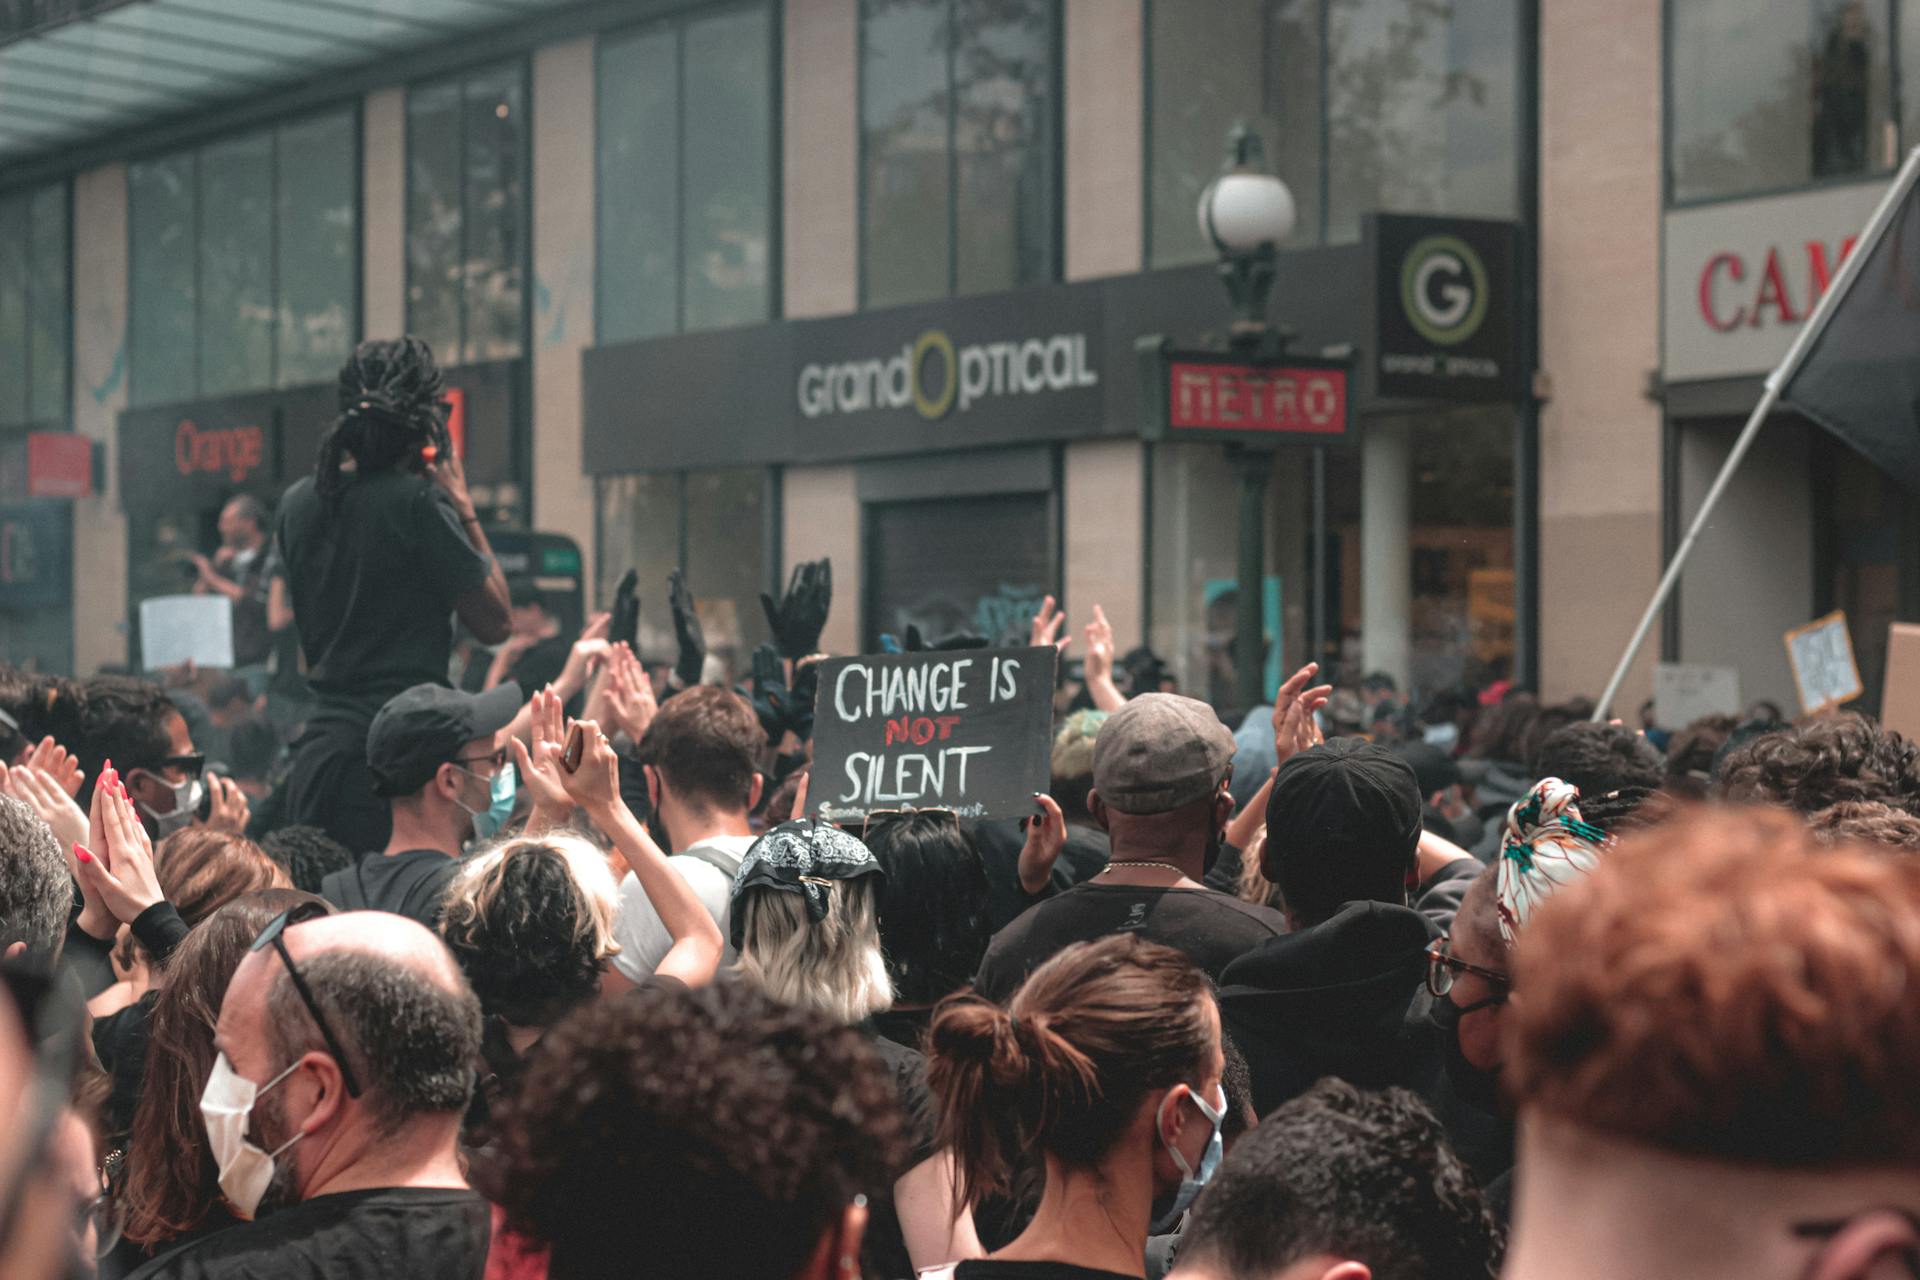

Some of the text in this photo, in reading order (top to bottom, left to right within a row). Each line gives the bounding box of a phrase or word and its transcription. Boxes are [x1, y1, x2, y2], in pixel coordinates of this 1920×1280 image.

[1413, 253, 1476, 328] G
[176, 419, 263, 481] Orange
[834, 656, 1021, 722] CHANGE IS
[884, 715, 960, 747] NOT
[840, 746, 992, 804] SILENT
